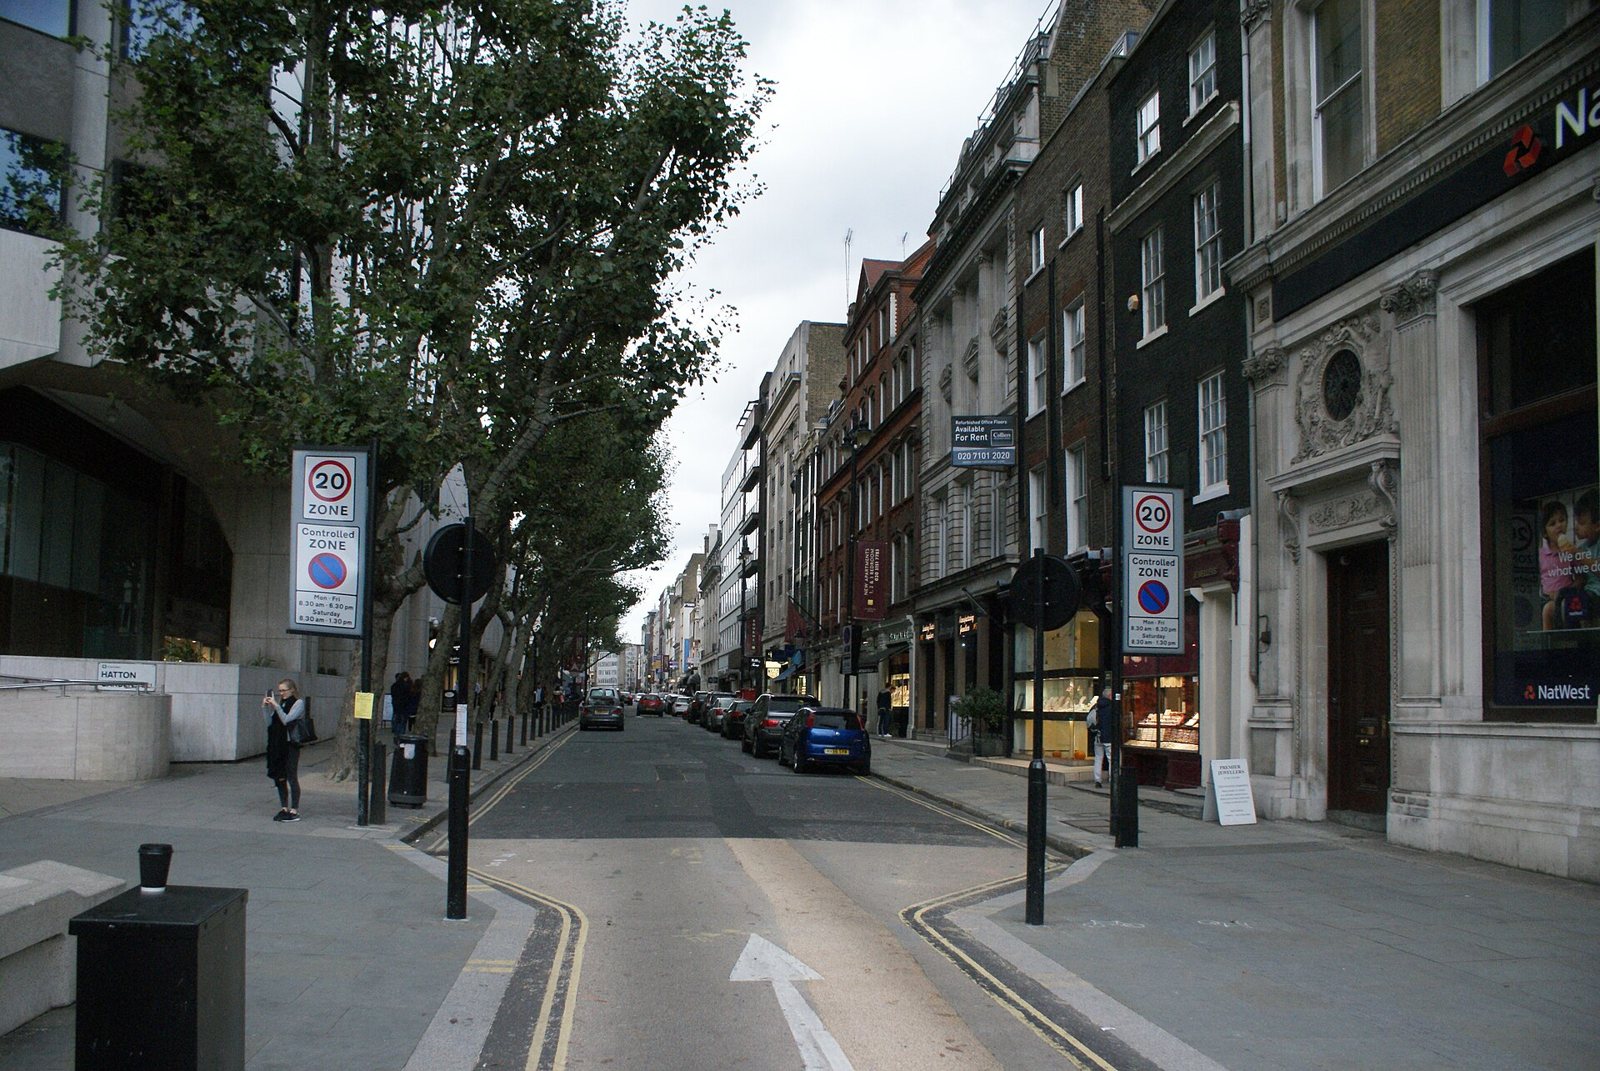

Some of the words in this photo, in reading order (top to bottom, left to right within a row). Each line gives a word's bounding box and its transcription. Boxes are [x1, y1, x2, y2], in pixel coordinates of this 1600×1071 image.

[315, 472, 345, 490] 20
[309, 504, 348, 516] ZONE
[1142, 506, 1165, 522] 20
[302, 527, 355, 539] Controlled
[309, 539, 346, 550] ZONE
[1138, 536, 1169, 546] ZONE
[1132, 558, 1175, 566] Controlled
[1558, 552, 1573, 563] We
[1575, 550, 1592, 560] are
[1138, 568, 1169, 578] ZONE
[1548, 566, 1572, 577] what
[1574, 565, 1588, 574] we
[312, 609, 340, 618] Saturday
[1538, 684, 1590, 699] NatWest
